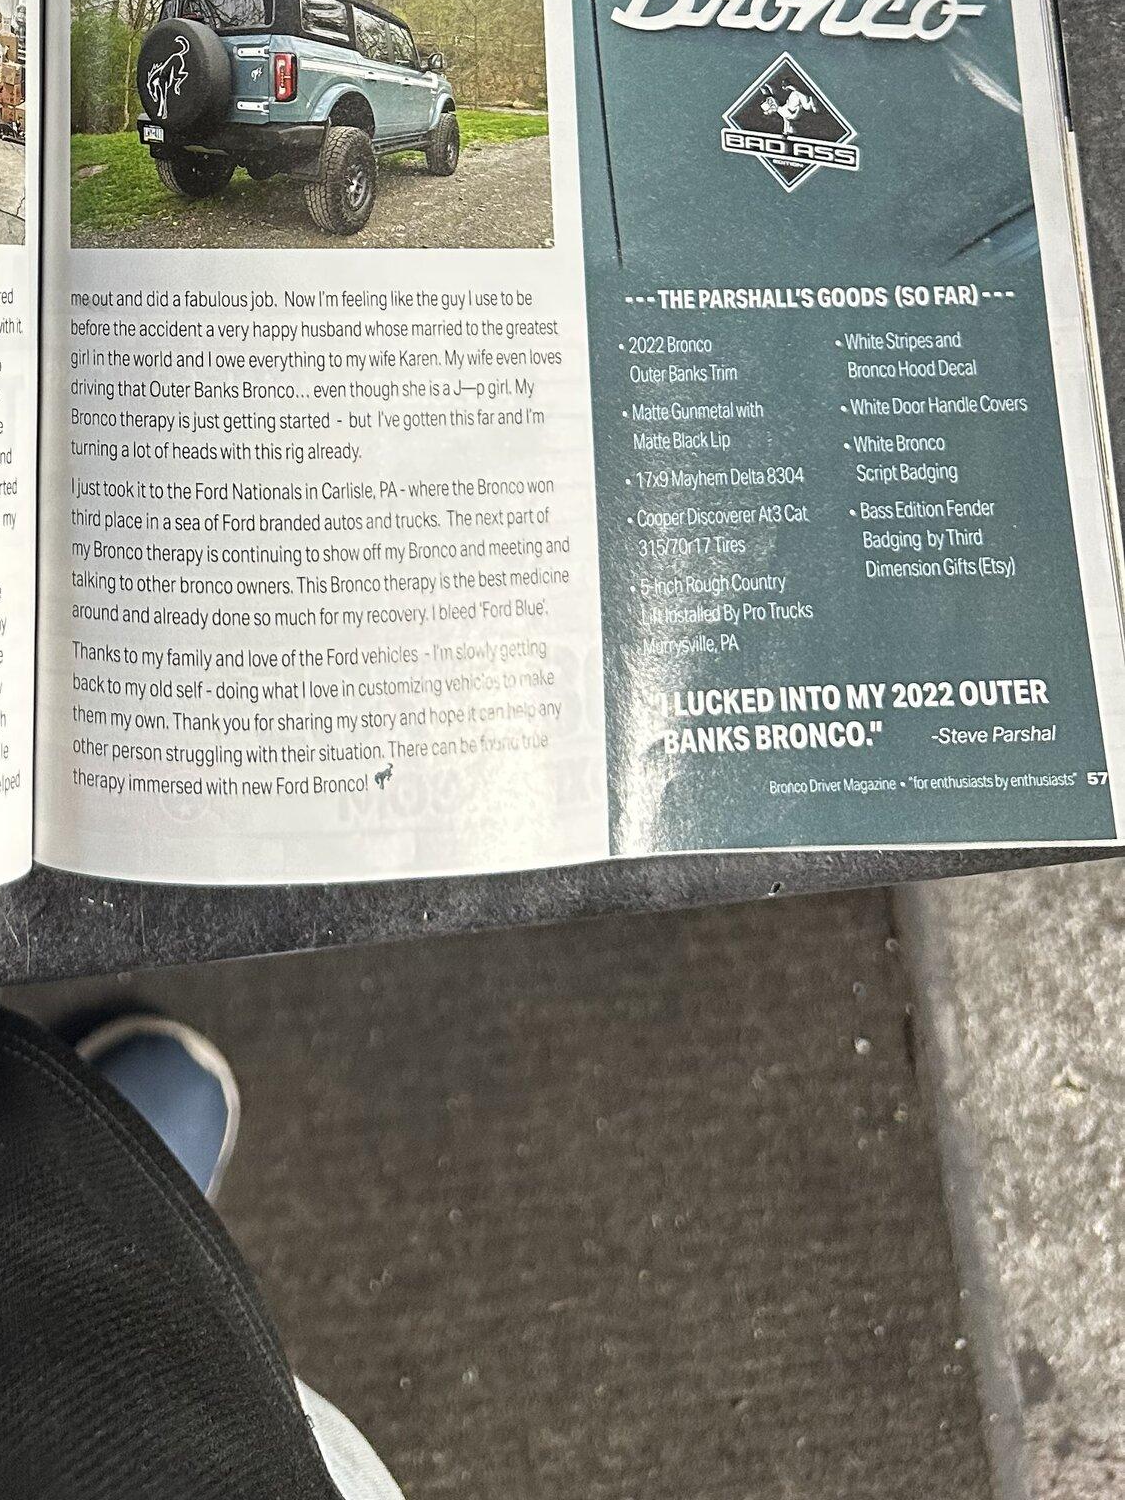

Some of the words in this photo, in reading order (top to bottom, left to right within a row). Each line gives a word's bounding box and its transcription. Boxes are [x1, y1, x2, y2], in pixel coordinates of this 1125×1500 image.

[725, 134, 786, 154] BAD
[793, 143, 856, 165] ASS
[698, 287, 814, 309] PARSHALL'S
[816, 286, 888, 308] GOODS
[894, 284, 930, 308] (SO
[70, 318, 110, 336] before
[112, 319, 136, 337] the
[138, 319, 203, 338] accident
[205, 323, 214, 338] a
[217, 323, 250, 342] very
[252, 320, 298, 342] happy
[300, 320, 362, 338] husband
[364, 320, 408, 337] whose
[411, 319, 462, 336] married
[465, 320, 479, 336] to
[481, 320, 503, 336] the
[505, 320, 558, 340] greatest
[843, 332, 884, 350] White
[885, 331, 934, 352] Stripes
[934, 330, 962, 348] and
[847, 361, 896, 378] Bronco
[897, 359, 936, 377] Hood
[937, 358, 977, 377] Decal
[849, 397, 890, 415] White
[891, 397, 926, 414] Door
[927, 395, 978, 413] Handle
[979, 394, 1028, 413] Covers
[852, 435, 894, 453] White
[895, 434, 946, 452] Bronco
[855, 463, 899, 485] Script
[899, 462, 958, 484] Badging
[859, 501, 894, 519] Bass
[894, 500, 944, 518] Edition
[945, 498, 995, 517] Fender
[862, 529, 922, 552] Badging
[925, 529, 944, 551] by
[944, 527, 983, 546] Third
[865, 558, 941, 578] Dimension
[942, 557, 977, 576] Gifts
[978, 555, 1015, 578] (Etsy)
[673, 687, 775, 716] LUCKED
[779, 684, 841, 712] INTO
[845, 683, 886, 710] MY
[891, 681, 955, 708] 2022
[958, 678, 1050, 707] OUTER
[663, 725, 751, 754] BANKS
[754, 720, 882, 750] BRONCO."
[930, 727, 988, 745] -Steve
[992, 724, 1056, 743] Parshal
[1086, 771, 1108, 786] 57
